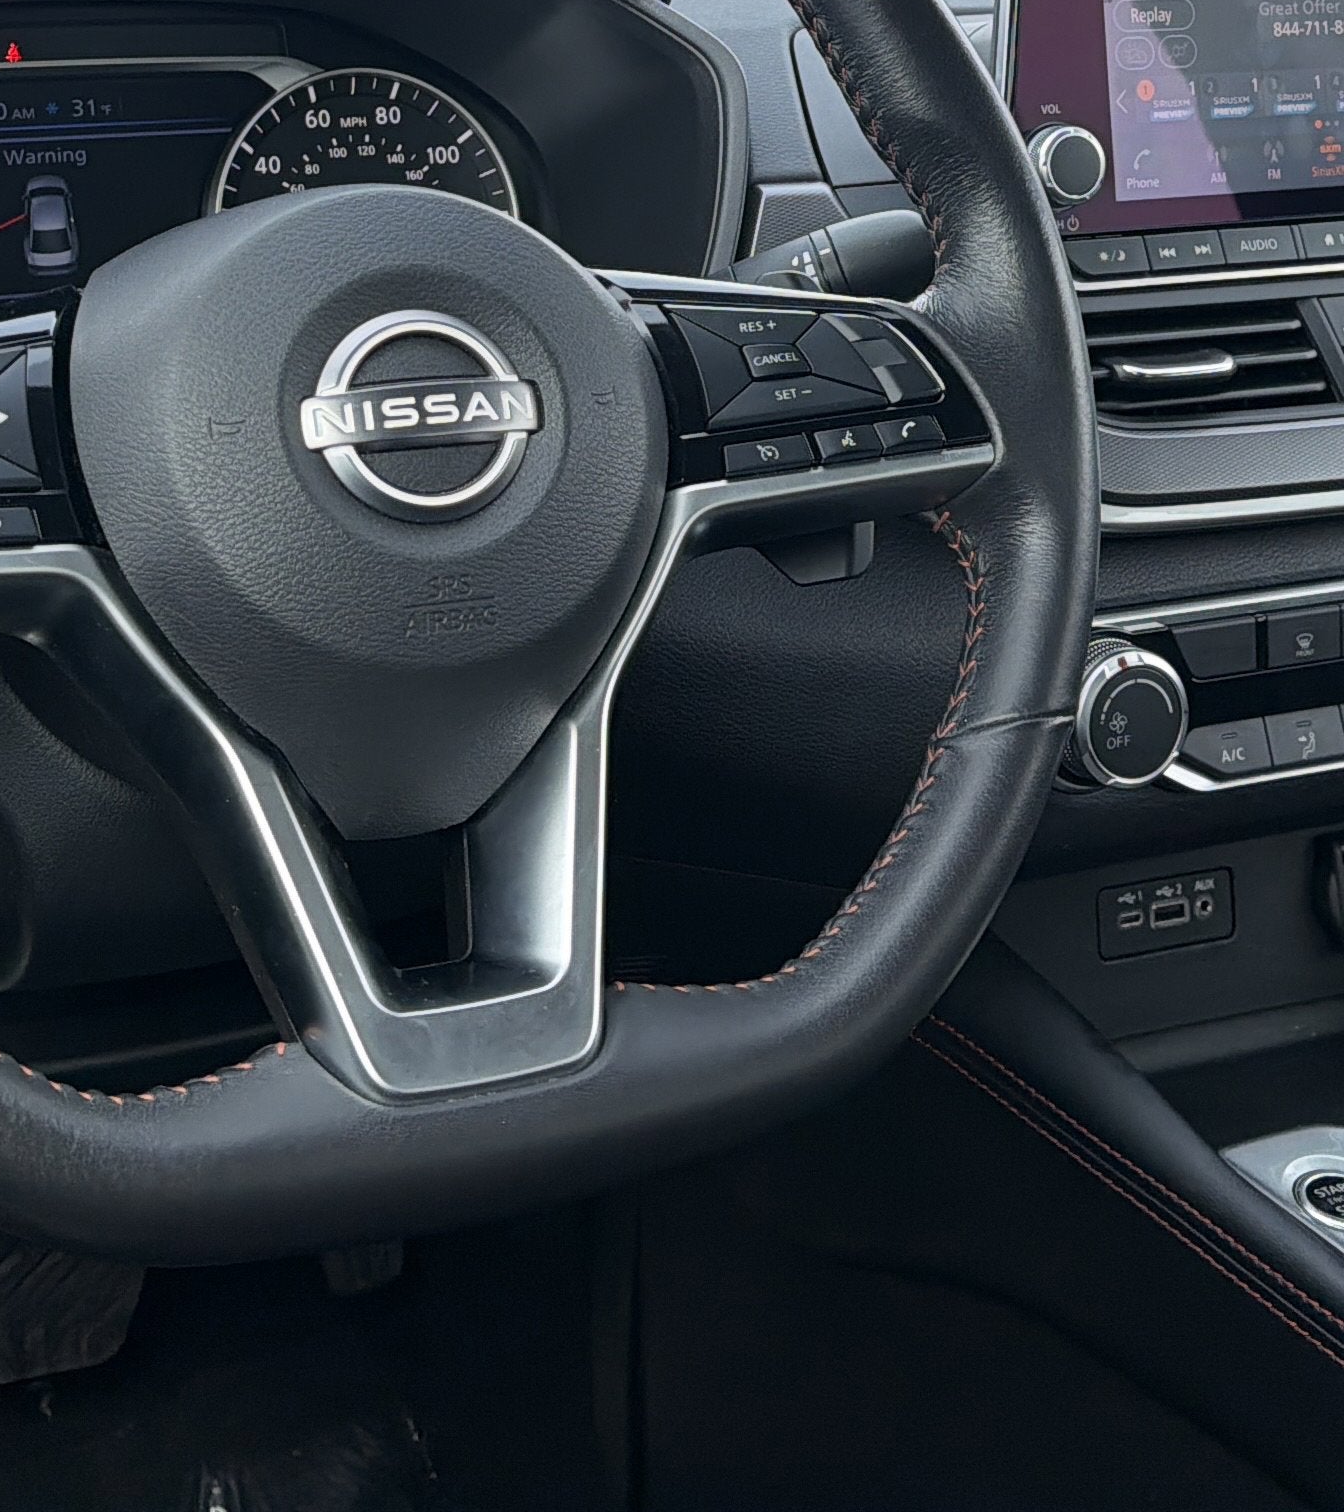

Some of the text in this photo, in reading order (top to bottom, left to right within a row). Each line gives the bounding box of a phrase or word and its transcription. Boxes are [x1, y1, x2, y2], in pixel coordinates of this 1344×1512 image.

[1259, 0, 1298, 16] Great
[1302, 0, 1339, 16] Offer
[1131, 6, 1172, 26] Replay
[12, 107, 36, 120] AM
[375, 106, 401, 125] 80
[1040, 104, 1061, 115] VOL
[306, 109, 331, 128] 60
[340, 116, 367, 128] MPH
[3, 147, 87, 166] Warning
[328, 147, 348, 158] 100
[357, 144, 376, 156] 120
[427, 145, 460, 165] 100
[255, 155, 281, 174] 40
[387, 153, 405, 165] 140
[305, 163, 320, 175] 80
[406, 169, 423, 181] 160
[1267, 168, 1282, 180] FM
[1126, 178, 1160, 189] Phone
[1210, 172, 1227, 184] AM
[1240, 238, 1278, 251] AUDIO
[739, 320, 764, 333] RES
[753, 352, 800, 367] CANCEL
[774, 388, 797, 401] SET
[311, 389, 534, 437] NISSAN
[1106, 734, 1131, 750] OFF
[1221, 747, 1246, 763] A/C
